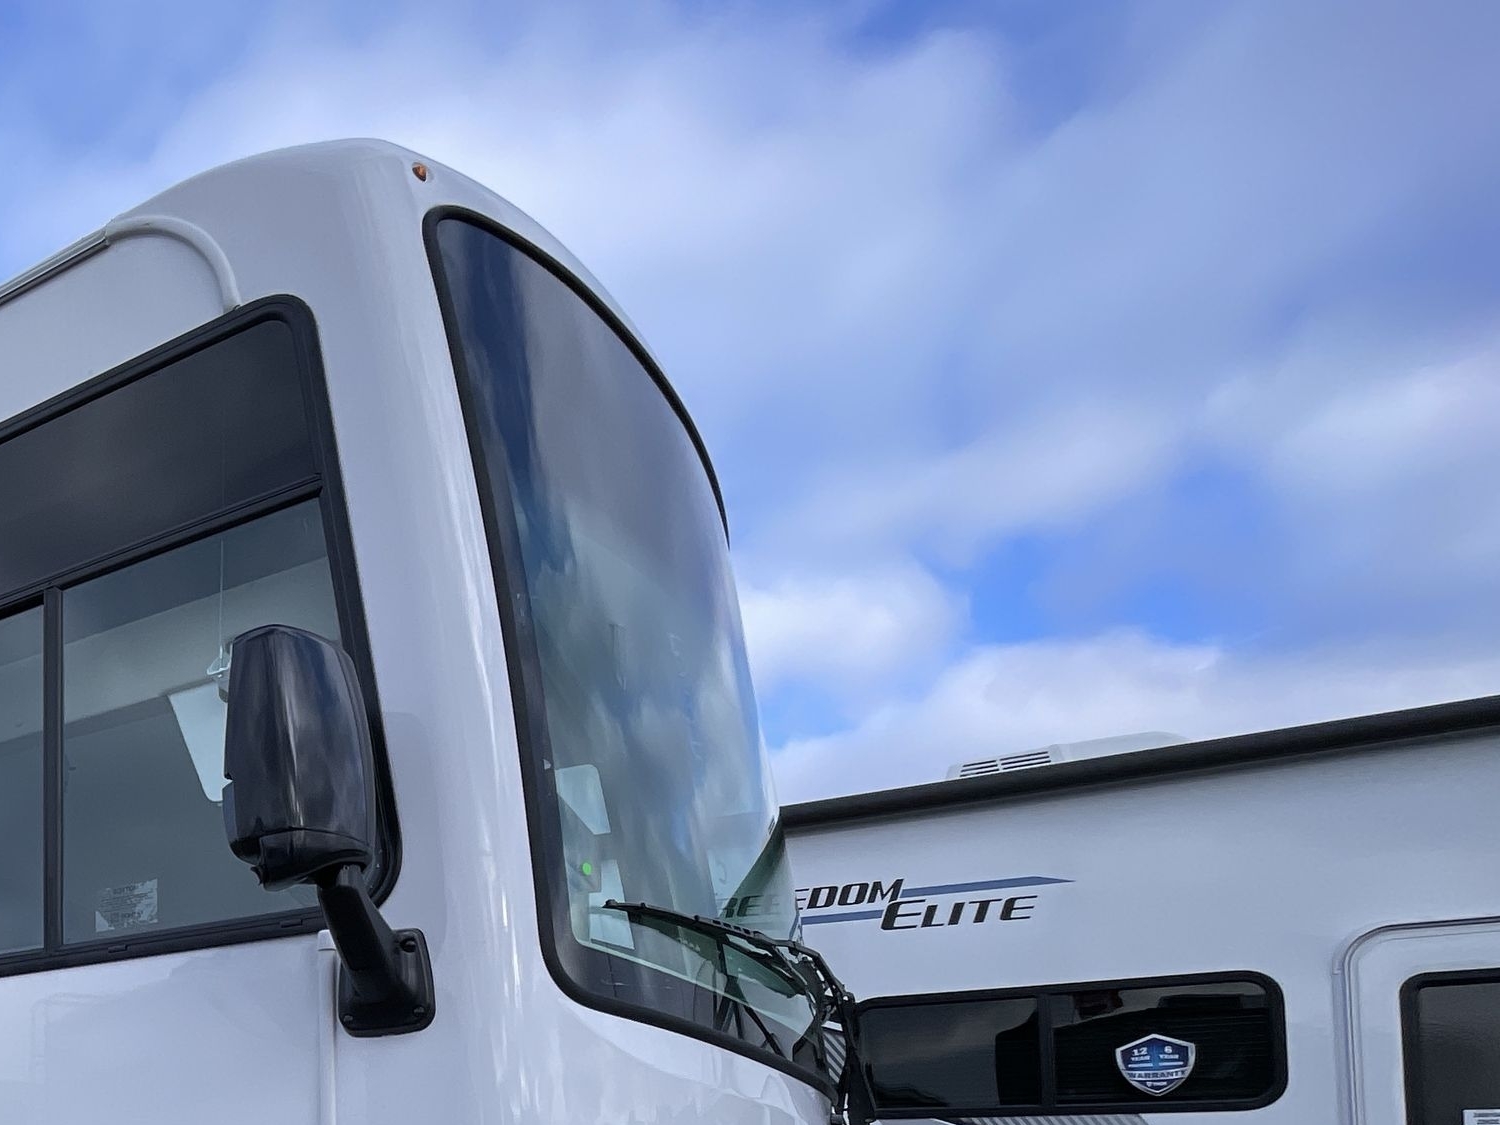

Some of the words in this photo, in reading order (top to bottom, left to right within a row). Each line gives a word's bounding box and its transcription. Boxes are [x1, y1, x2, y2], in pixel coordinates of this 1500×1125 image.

[880, 894, 1038, 930] ELITE
[1132, 1047, 1148, 1056] 12
[1164, 1046, 1172, 1054] 6
[1127, 1069, 1187, 1080] WARRANTY
